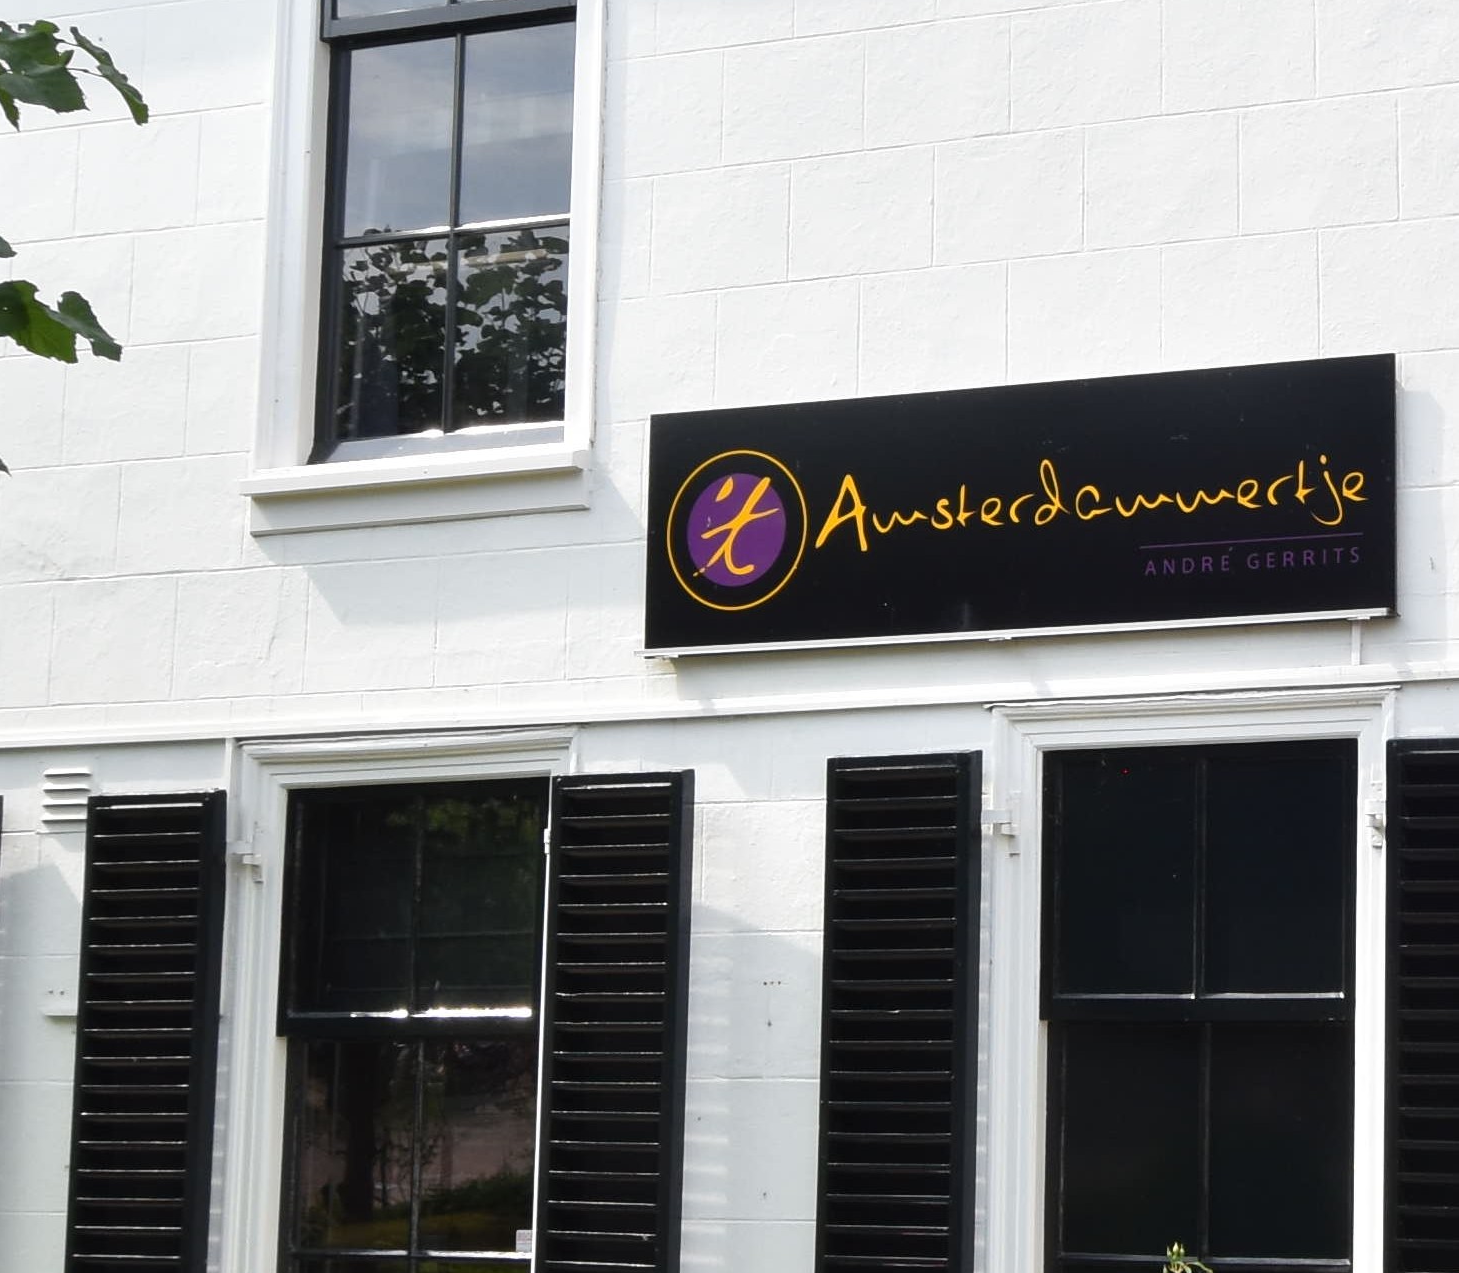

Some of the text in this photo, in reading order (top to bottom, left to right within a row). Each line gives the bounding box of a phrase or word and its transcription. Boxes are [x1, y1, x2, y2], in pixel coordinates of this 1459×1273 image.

[814, 454, 1370, 552] Amsterdammertje
[1144, 546, 1361, 577] ANDRÉ GERRITS
